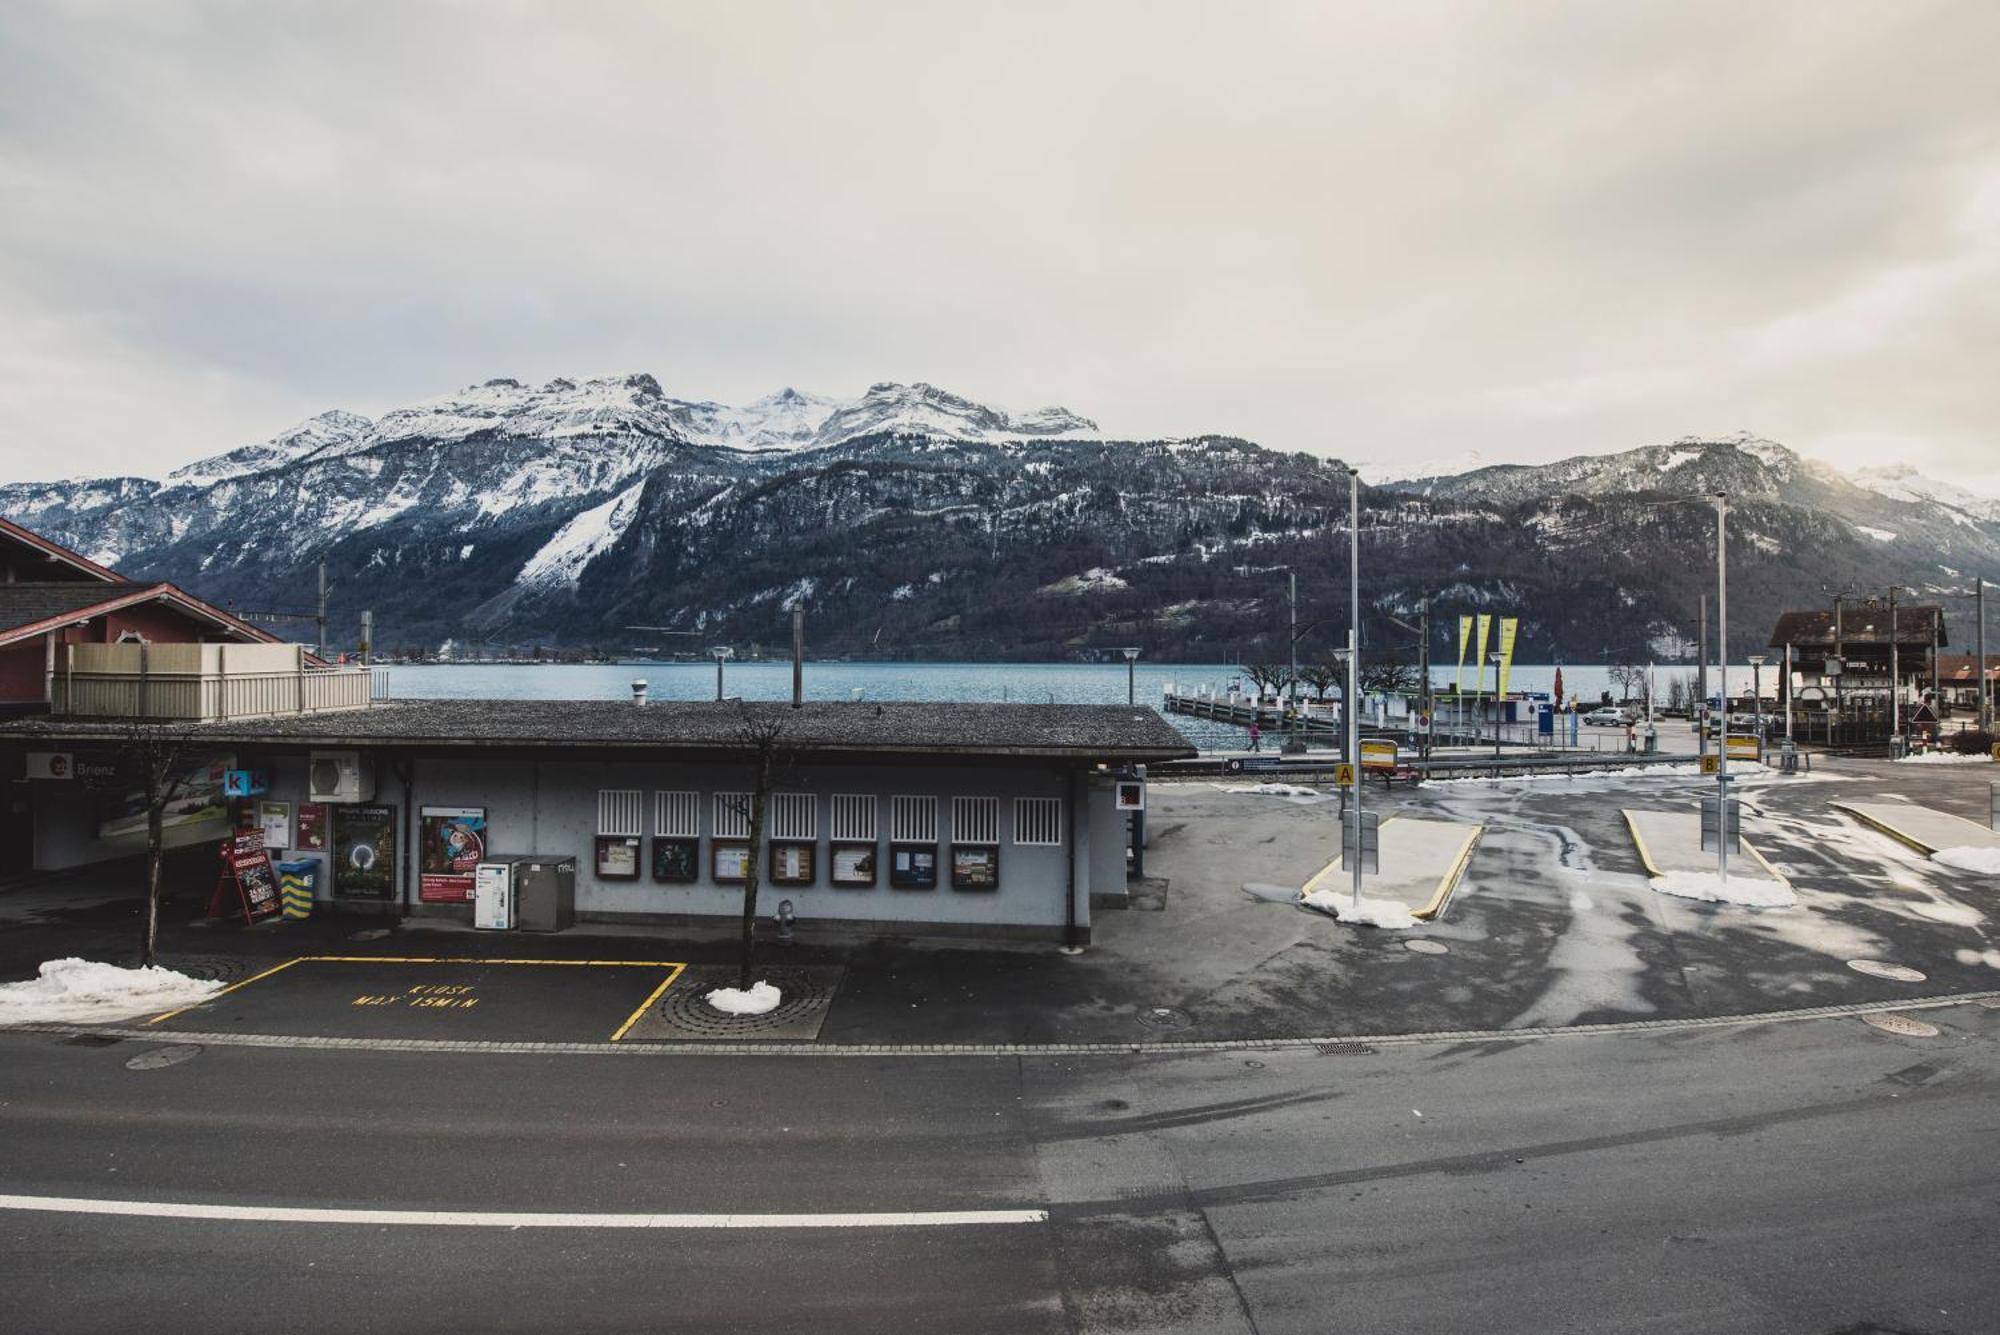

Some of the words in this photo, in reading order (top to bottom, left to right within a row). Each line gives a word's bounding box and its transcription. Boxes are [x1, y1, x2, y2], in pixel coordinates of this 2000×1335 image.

[1706, 758, 1714, 771] B
[1340, 767, 1351, 781] A
[408, 984, 476, 995] KIOSK
[352, 995, 401, 1006] MAX
